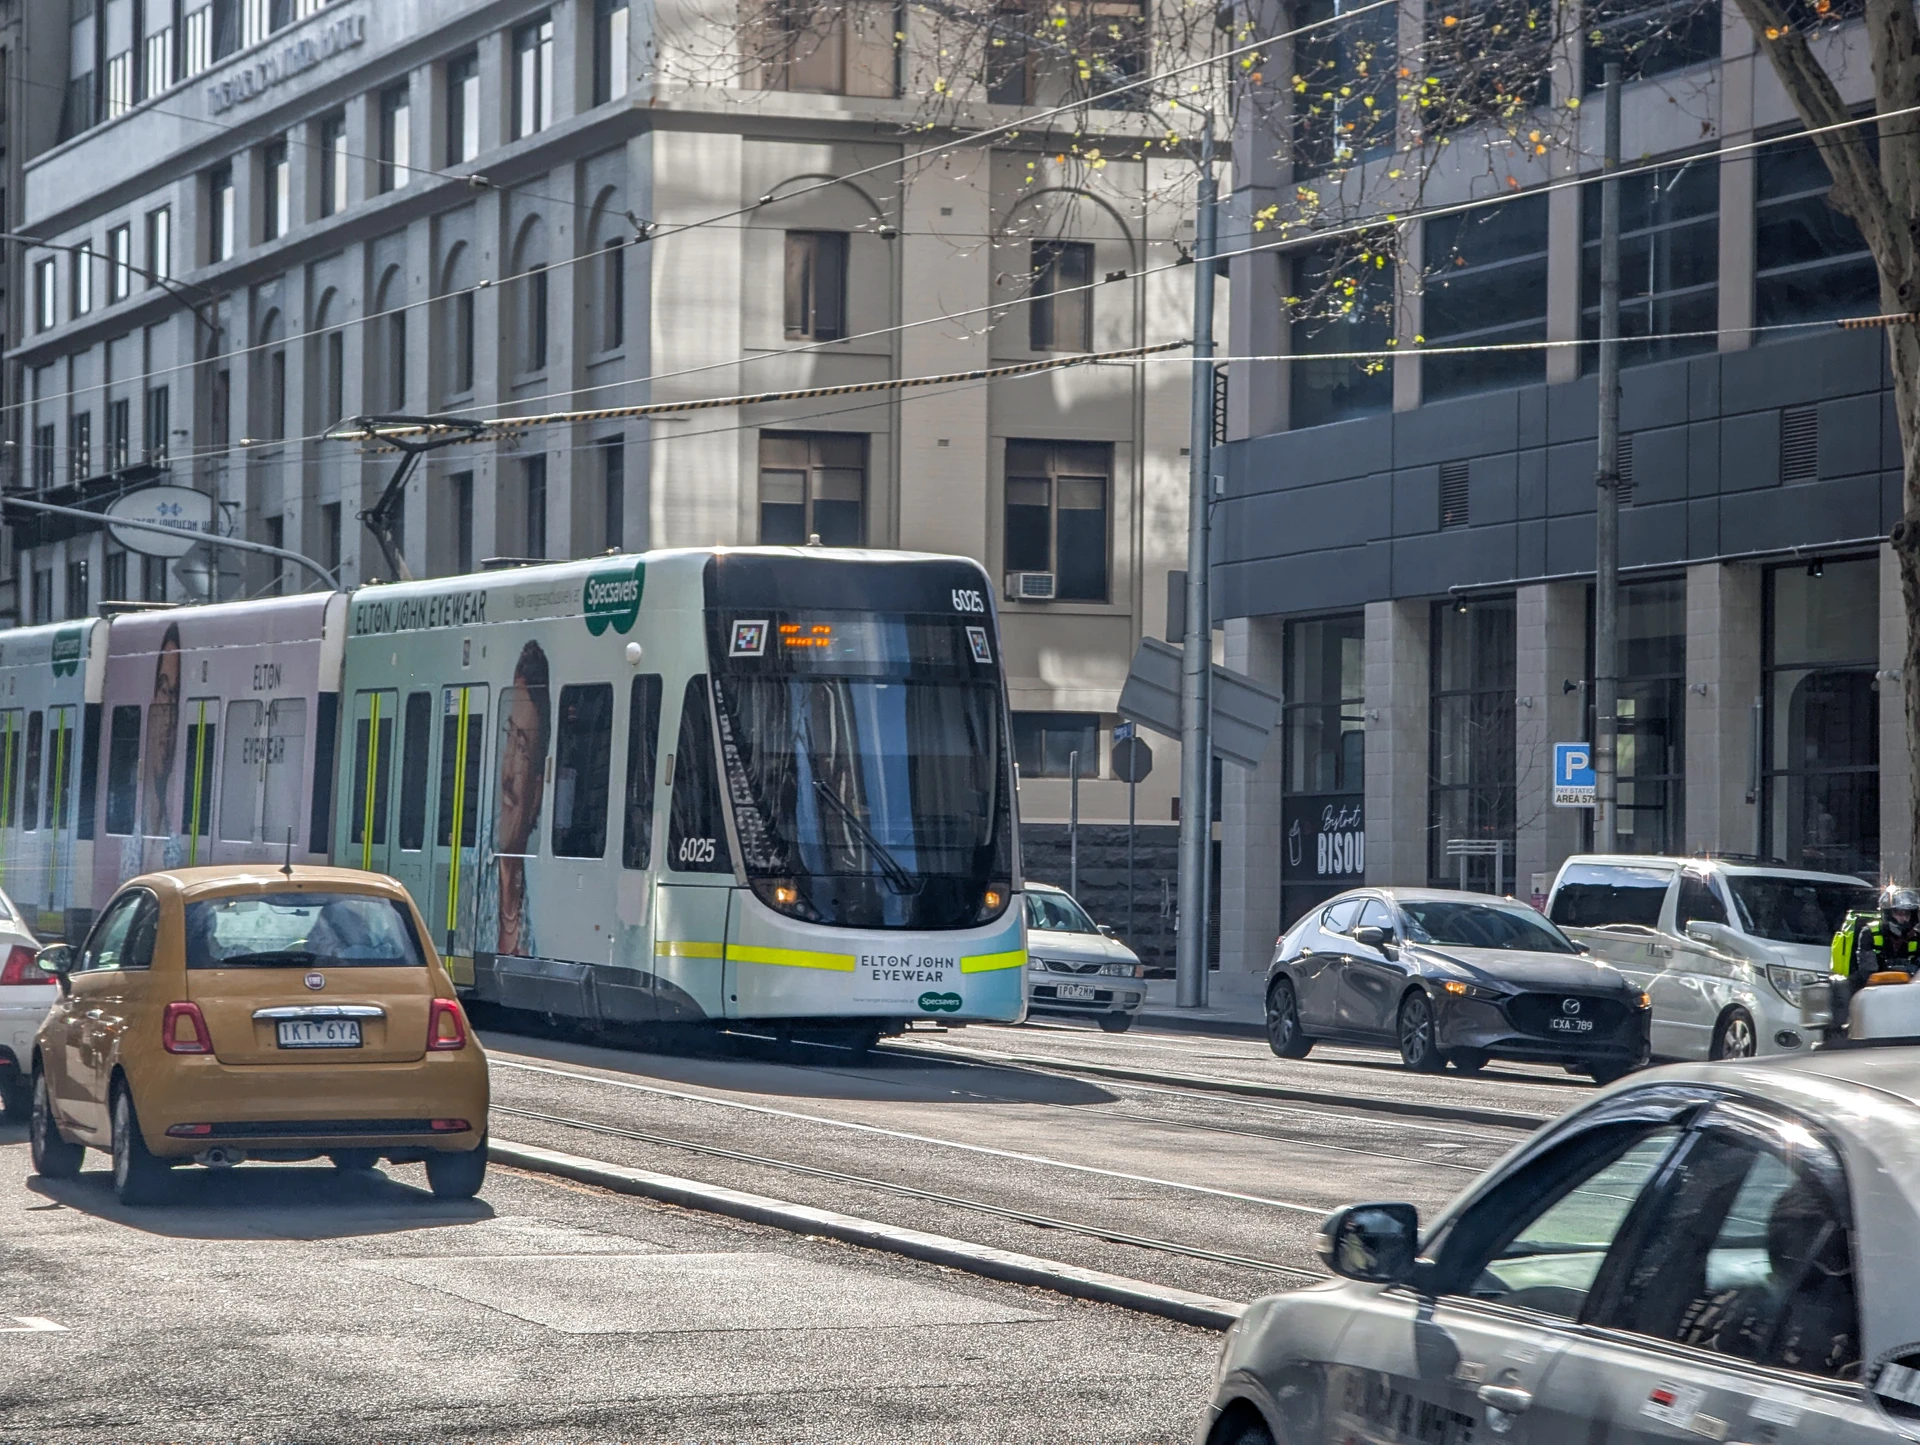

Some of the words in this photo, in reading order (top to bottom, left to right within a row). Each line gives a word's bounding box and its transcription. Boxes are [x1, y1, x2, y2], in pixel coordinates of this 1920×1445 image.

[588, 579, 639, 609] Specsavers
[952, 589, 985, 612] 6025
[356, 602, 392, 634] ELTON
[394, 598, 427, 631] JOHN
[429, 590, 487, 627] EYEWEAR
[253, 664, 281, 690] ELTON
[1565, 752, 1589, 780] P
[1556, 795, 1580, 803] AREA
[679, 837, 716, 862] 6025
[1317, 832, 1364, 874] BISOU
[861, 955, 912, 968] ELTON
[916, 957, 954, 968] JOHN
[872, 970, 943, 982] EYEWEAR
[921, 997, 960, 1006] Specsavers
[327, 1023, 359, 1040] 6YA
